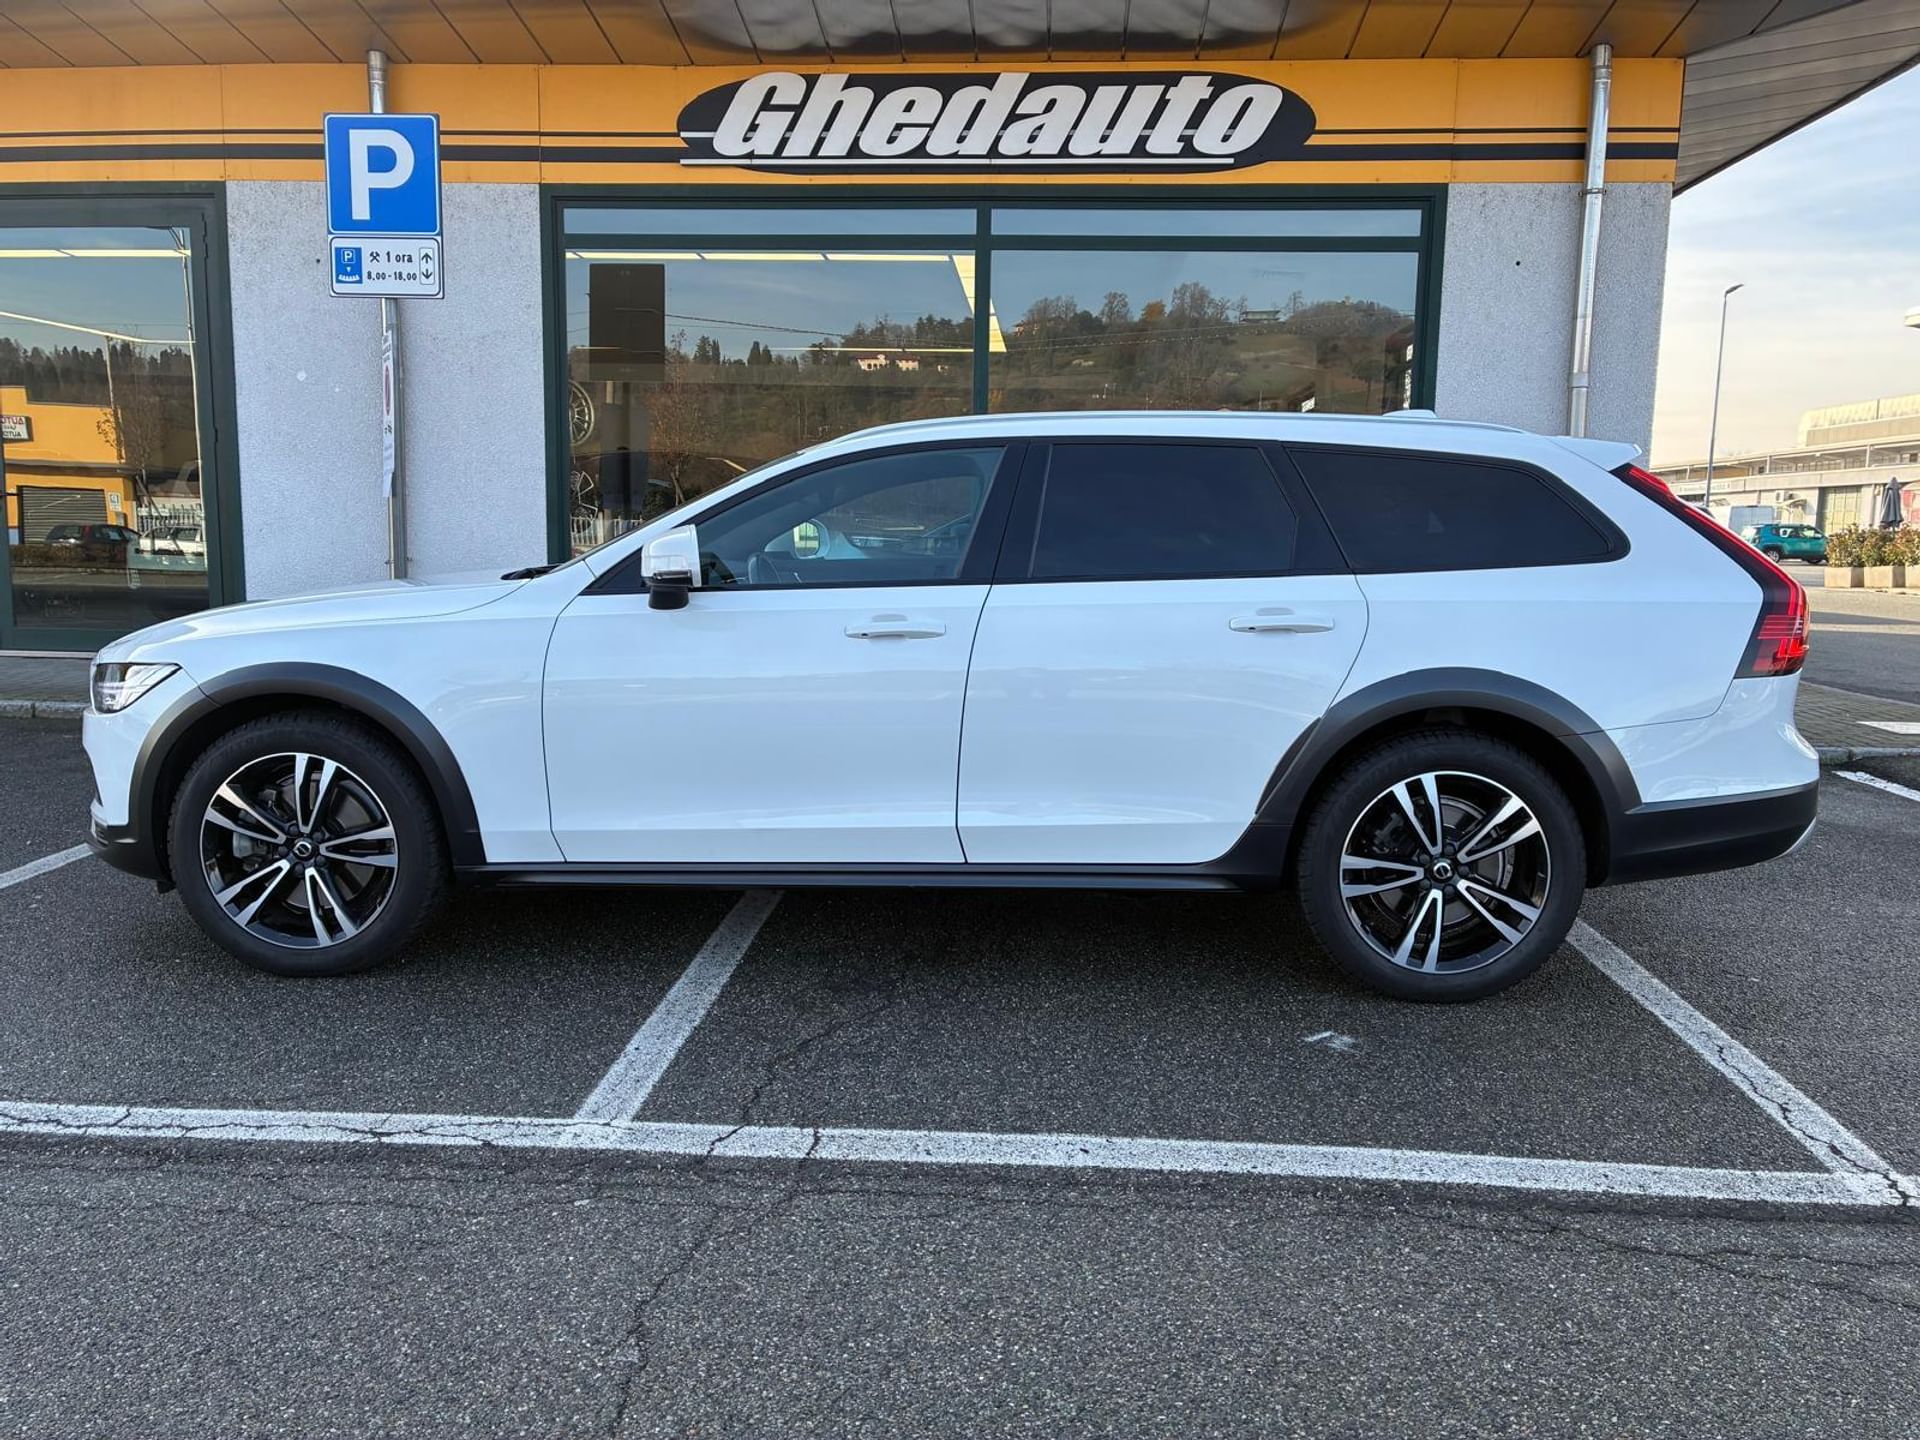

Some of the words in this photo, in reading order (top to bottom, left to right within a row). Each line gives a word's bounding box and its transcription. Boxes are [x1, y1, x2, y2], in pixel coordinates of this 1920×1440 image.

[712, 71, 1283, 157] Ghedauto
[348, 128, 416, 221] P
[344, 251, 353, 262] P
[386, 251, 391, 263] 1
[395, 254, 413, 263] ora
